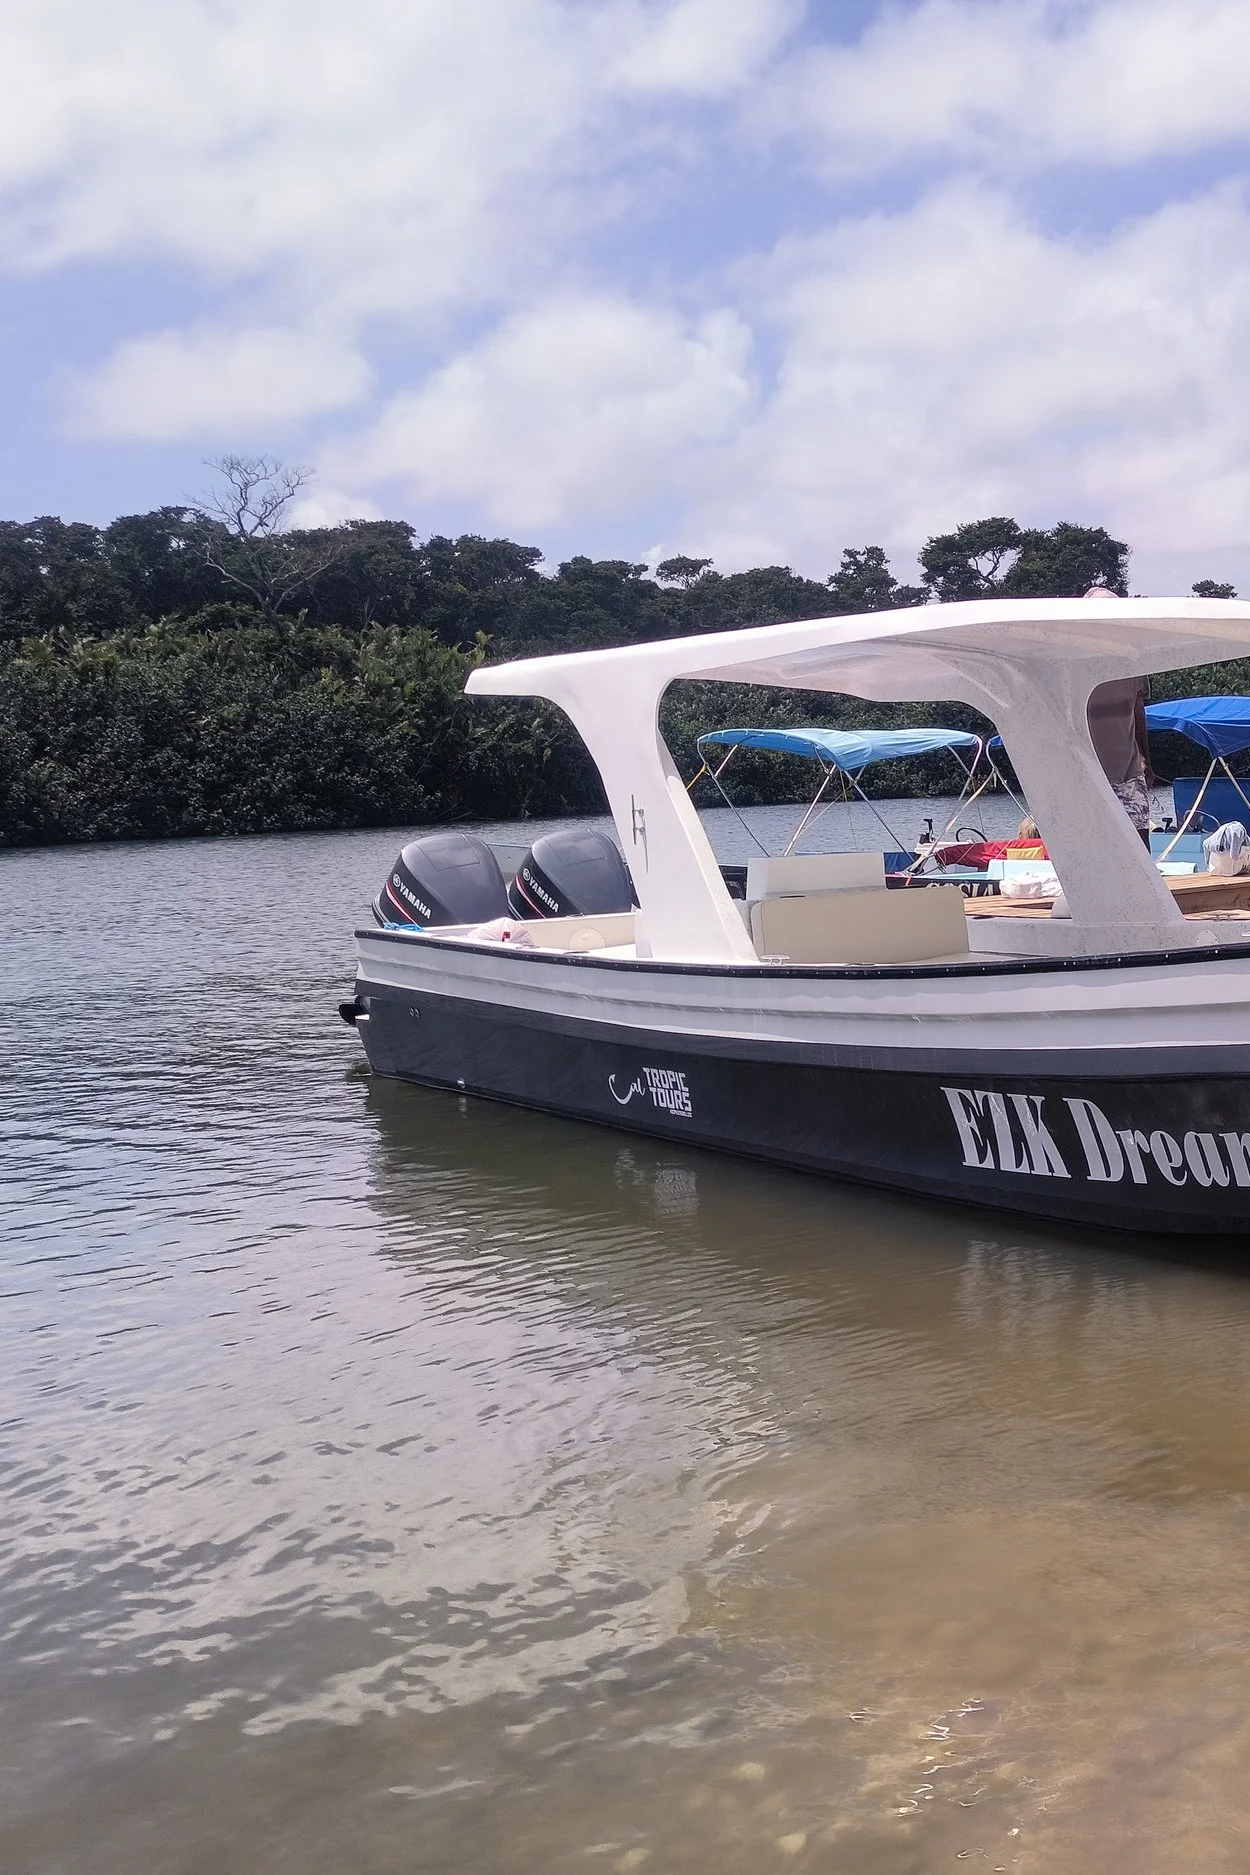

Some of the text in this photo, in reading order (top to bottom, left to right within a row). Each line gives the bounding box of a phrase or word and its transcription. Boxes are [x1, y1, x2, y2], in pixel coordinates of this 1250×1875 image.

[399, 882, 432, 919] YAMAHA
[530, 876, 560, 913] YAMAHA
[642, 1067, 689, 1092] TROPIC
[649, 1086, 693, 1112] TOURS
